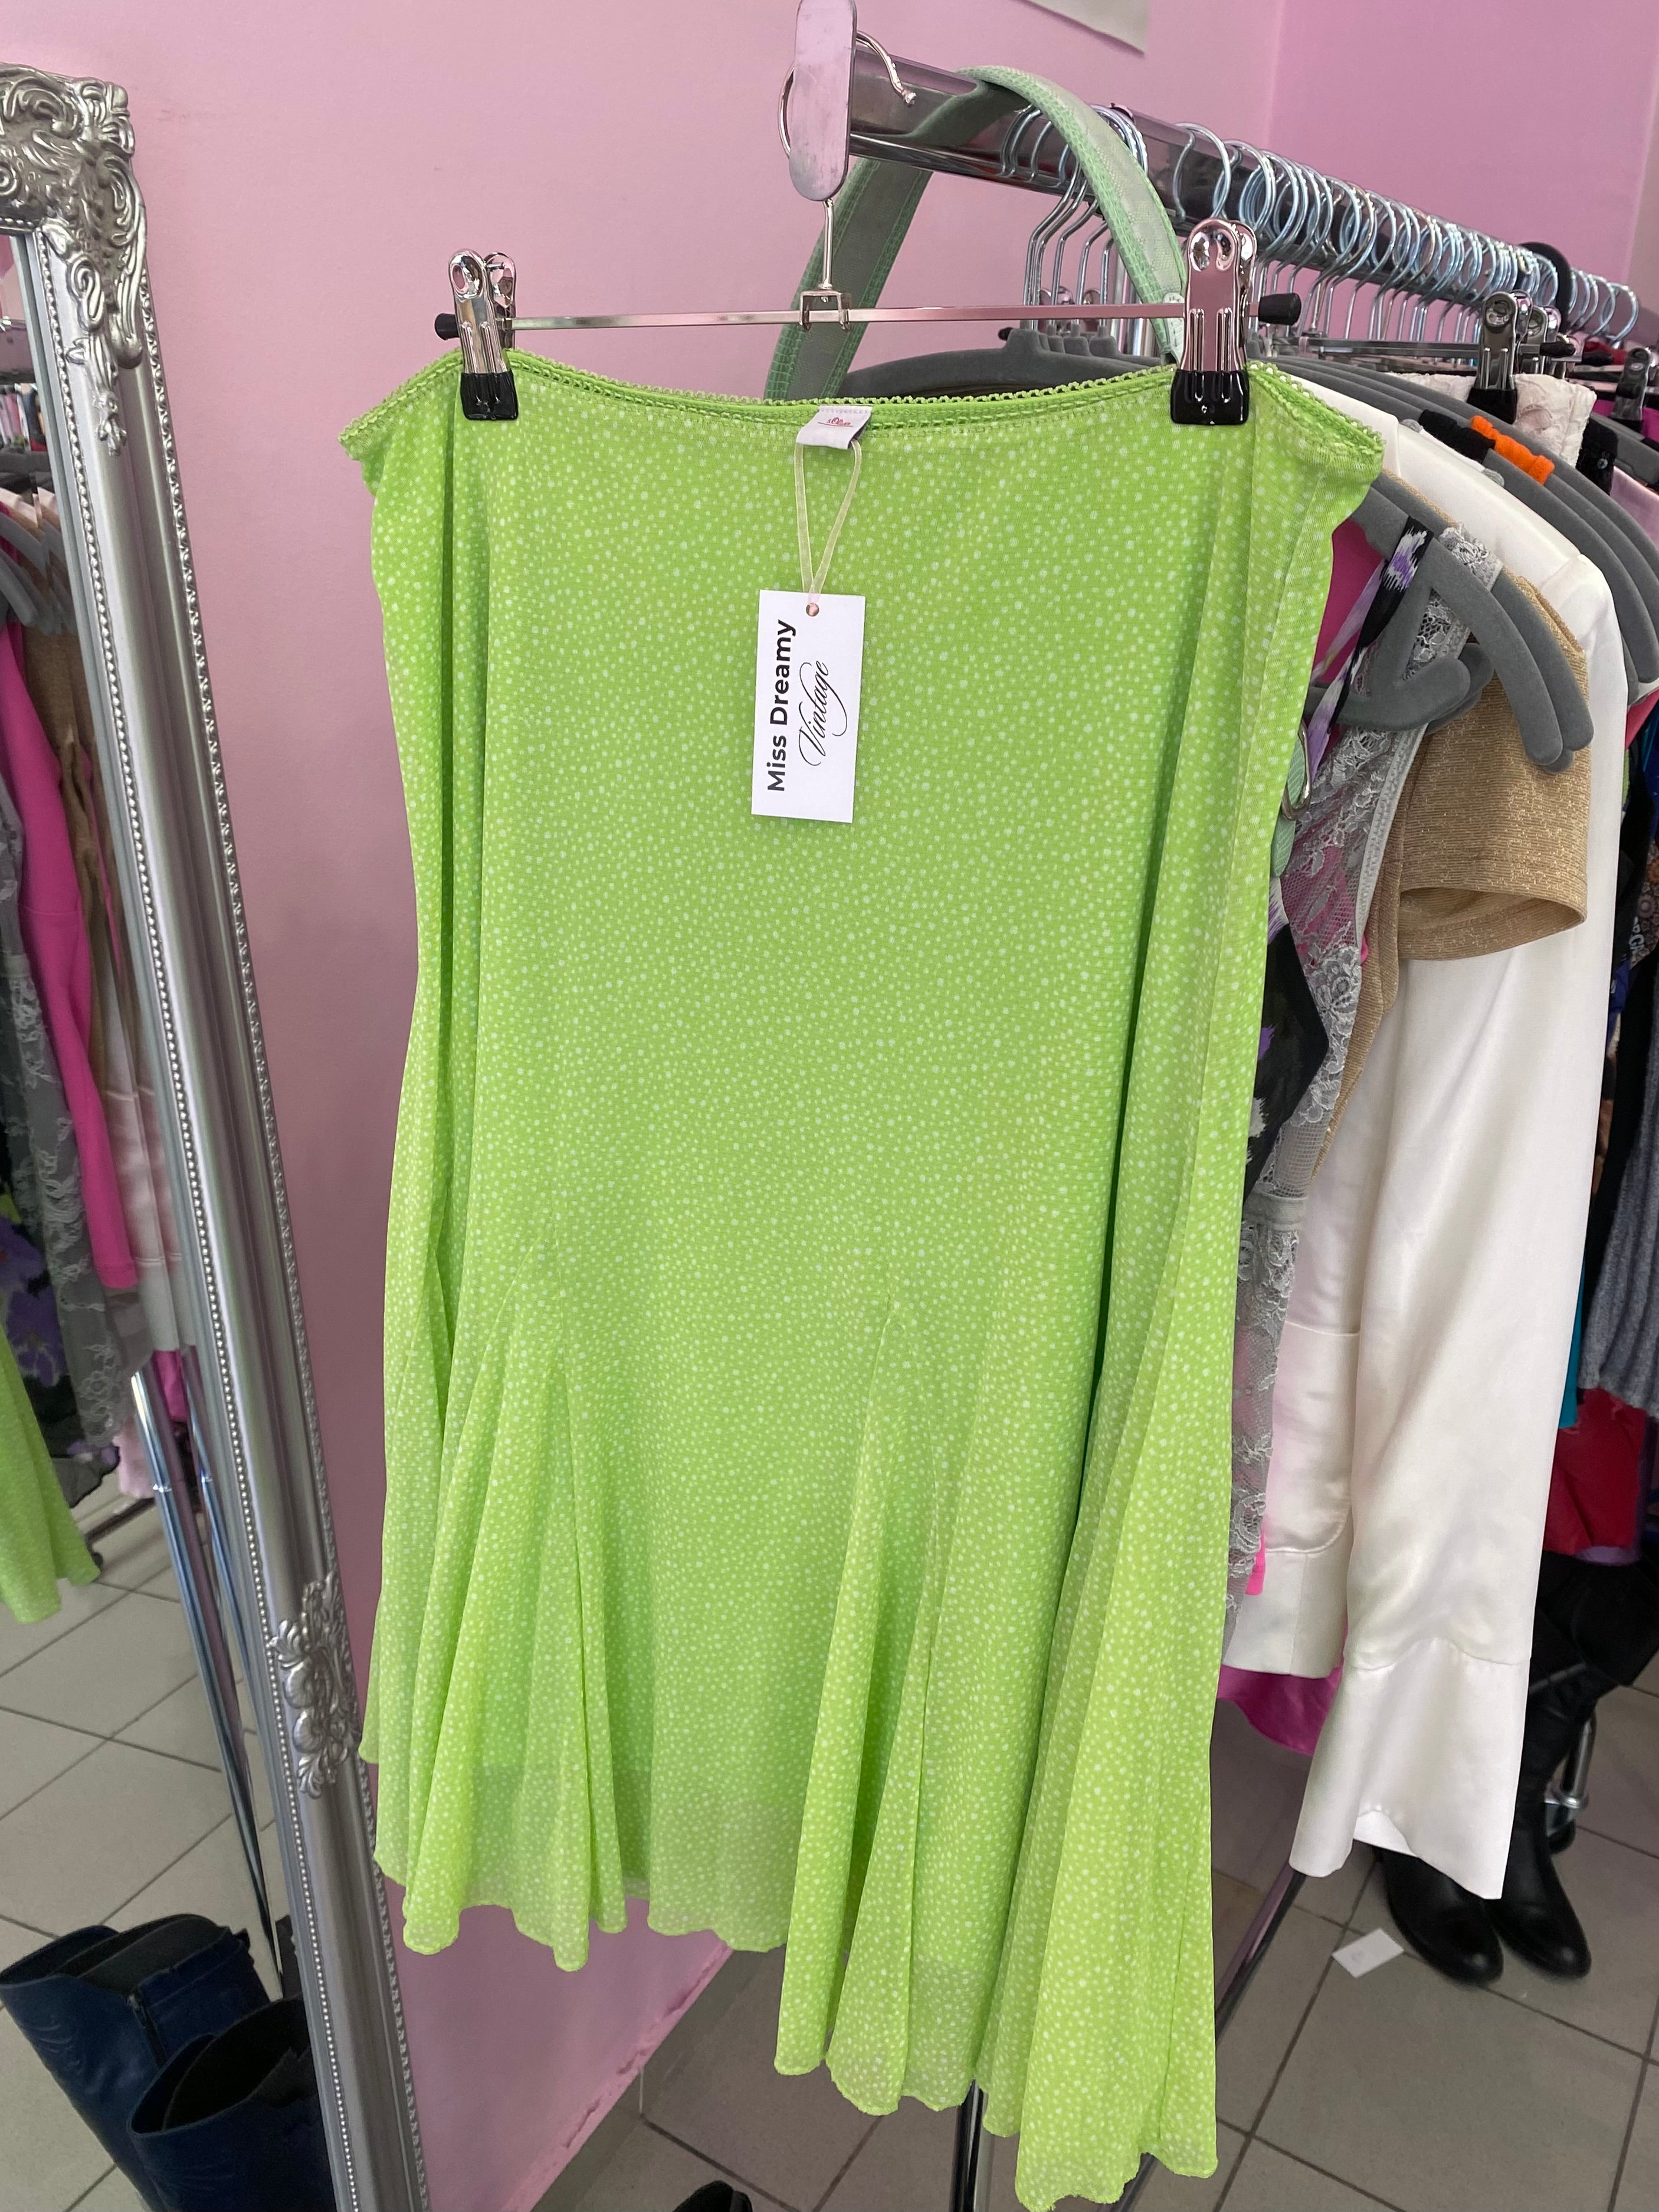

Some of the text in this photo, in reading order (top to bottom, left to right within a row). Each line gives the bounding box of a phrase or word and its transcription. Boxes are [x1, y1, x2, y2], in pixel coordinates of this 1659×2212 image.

[766, 619, 796, 791] Miss Dreamy
[798, 660, 848, 766] Vintage
